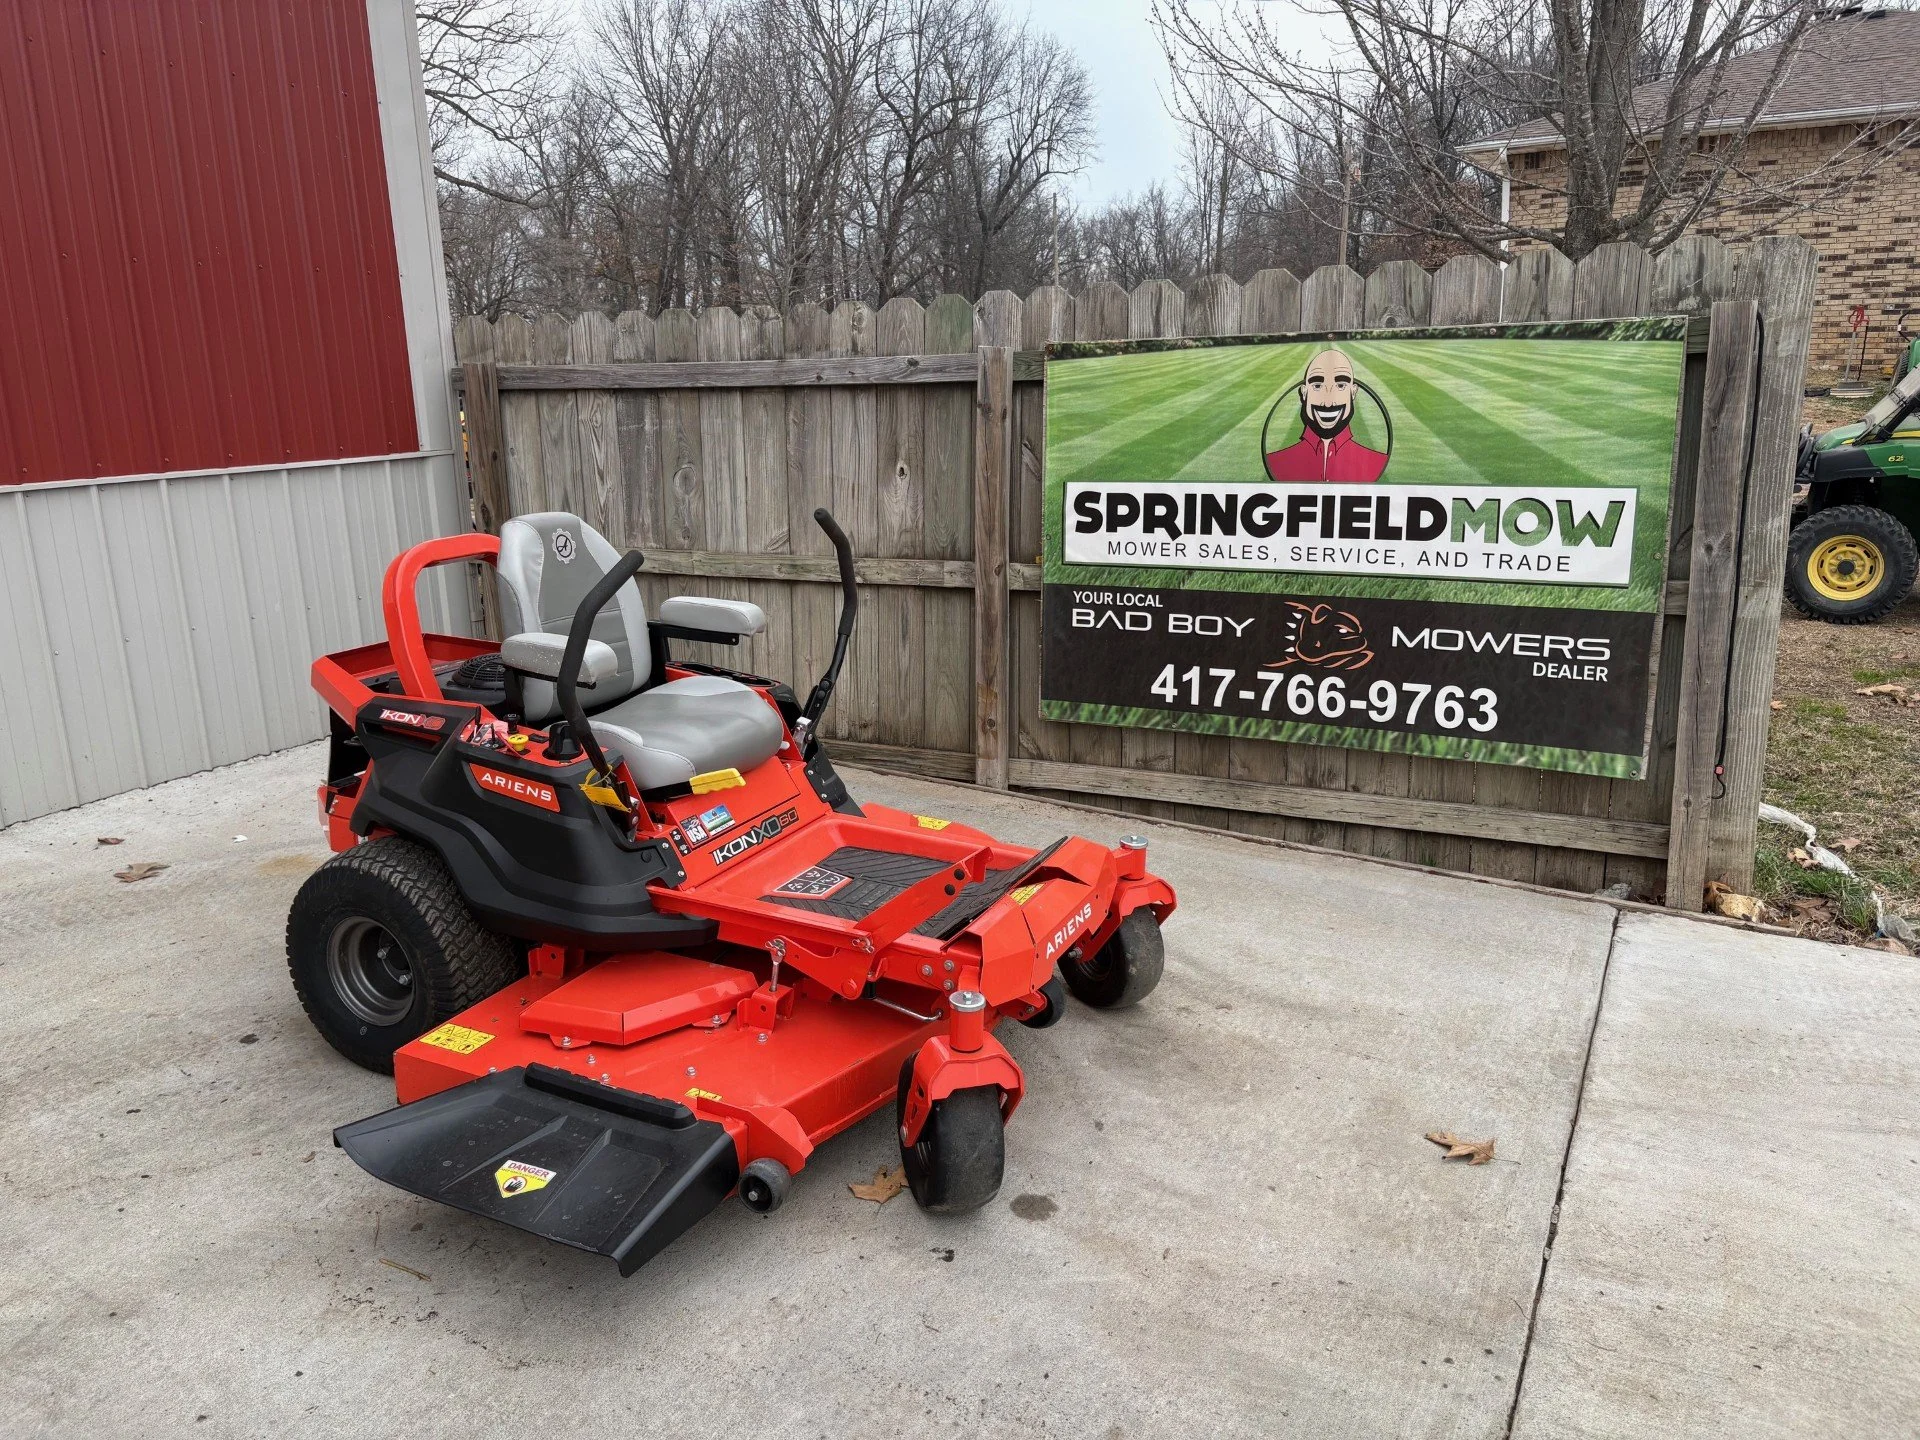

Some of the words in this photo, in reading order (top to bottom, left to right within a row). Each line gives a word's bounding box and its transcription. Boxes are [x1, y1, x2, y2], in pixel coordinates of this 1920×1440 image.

[1107, 540, 1187, 558] MOWER
[1198, 543, 1278, 563] SALES,
[1290, 546, 1405, 567] SERVICE,
[1417, 550, 1468, 568] AND
[1482, 552, 1571, 572] TRADE
[1073, 590, 1113, 605] YOUR
[1116, 593, 1163, 608] LOCAL
[1071, 608, 1152, 632] BAD
[1168, 613, 1255, 638] BOY
[1391, 625, 1611, 661] MOWERS
[1532, 661, 1608, 682] DEALER
[1150, 663, 1498, 732] 417-766-9763
[481, 772, 552, 802] ARIENS
[1045, 902, 1092, 960] ARIENS
[508, 1162, 550, 1178] DANGER
